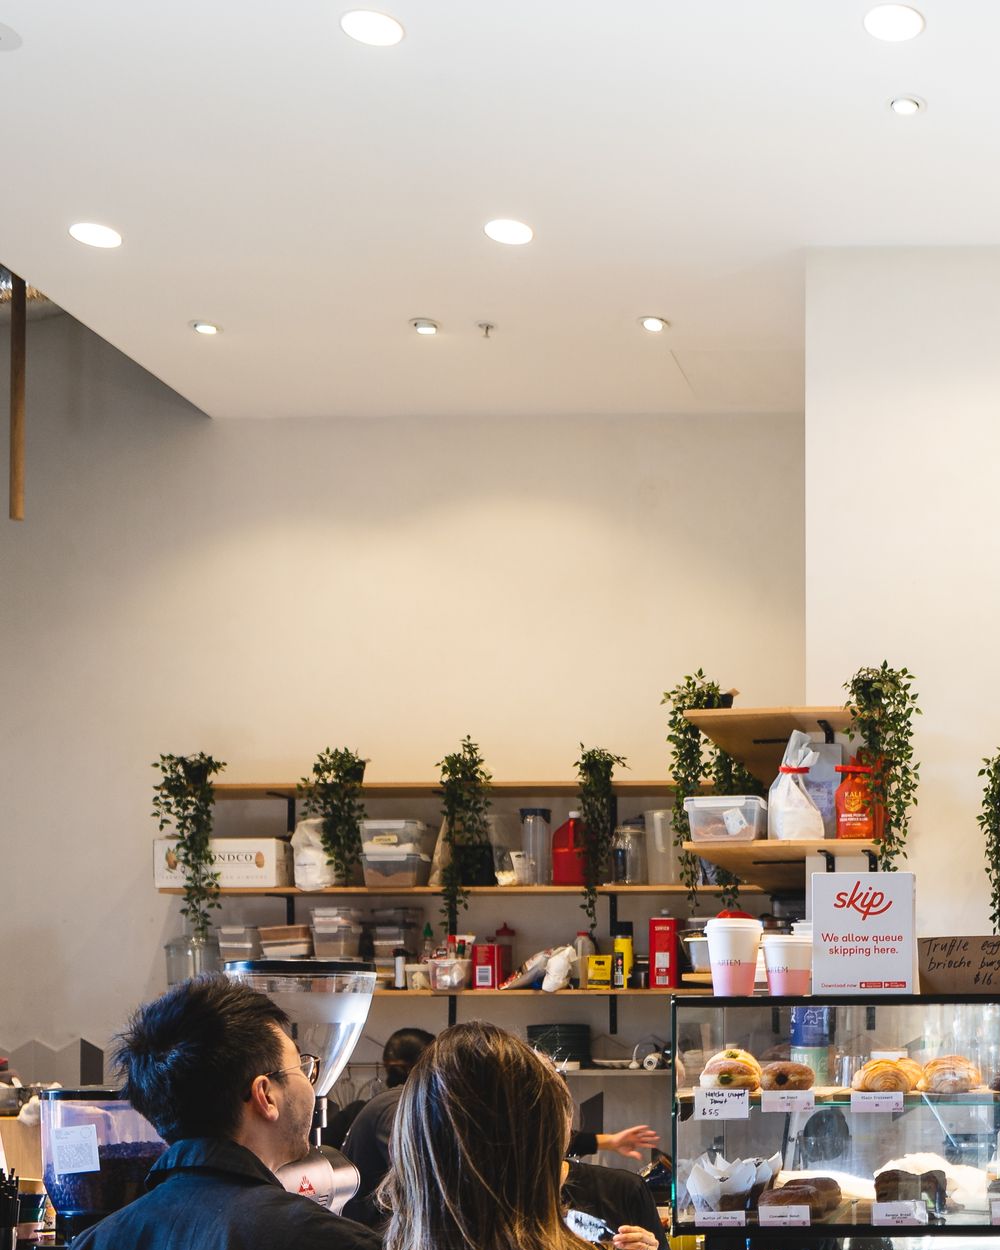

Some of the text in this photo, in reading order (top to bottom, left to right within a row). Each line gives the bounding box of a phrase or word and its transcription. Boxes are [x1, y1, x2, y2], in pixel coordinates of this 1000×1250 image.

[834, 881, 893, 920] skip
[822, 933, 904, 944] We allow queue
[829, 946, 898, 956] skipping here.
[922, 938, 968, 957] Truffle
[928, 956, 972, 972] brioche
